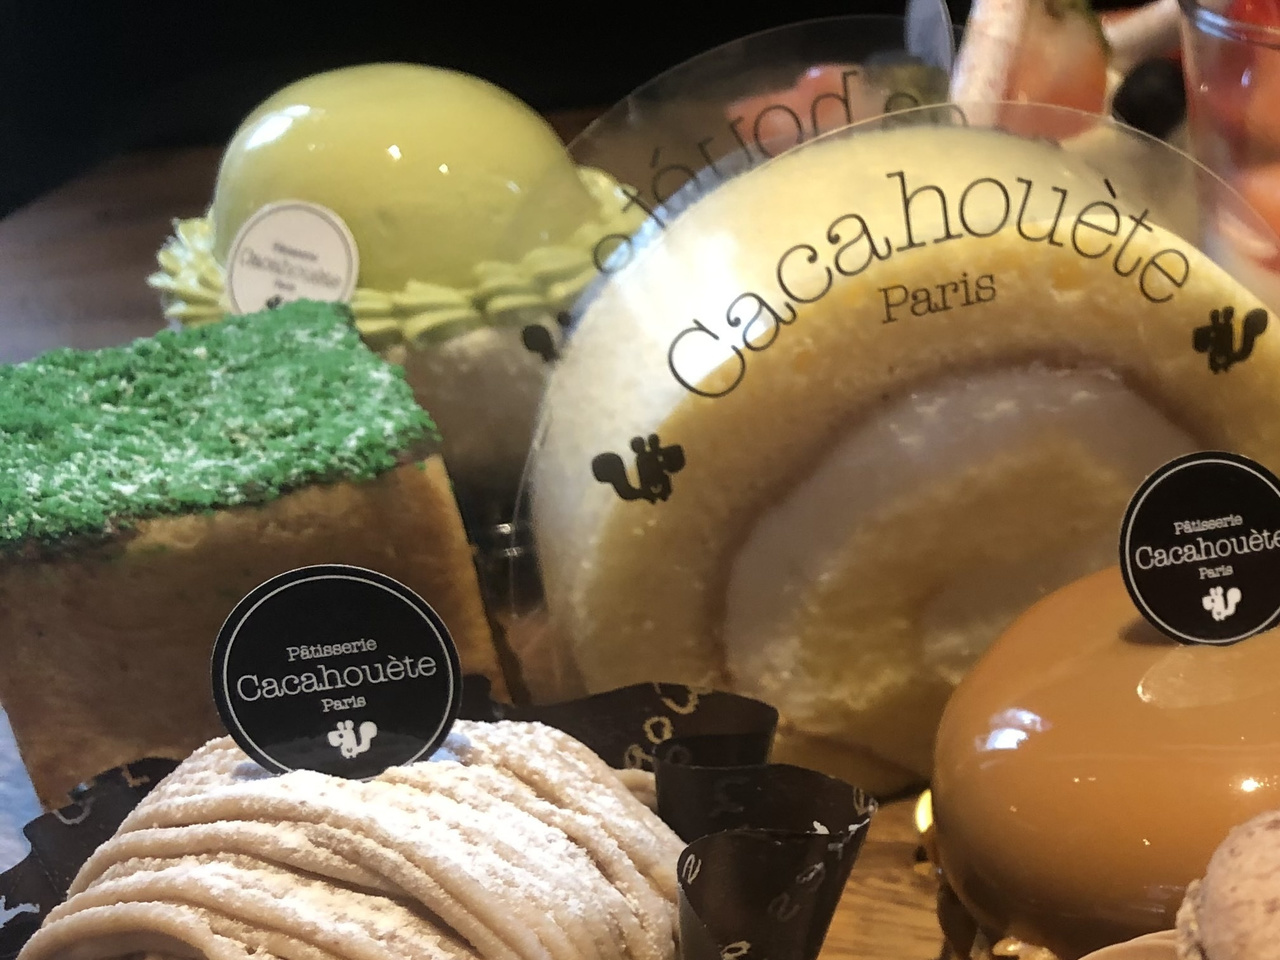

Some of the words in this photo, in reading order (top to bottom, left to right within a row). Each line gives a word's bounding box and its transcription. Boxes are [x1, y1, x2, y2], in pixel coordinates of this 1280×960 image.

[667, 169, 1191, 400] Cacahouète
[877, 270, 998, 325] Paris
[1173, 514, 1244, 536] Pâtisserie
[1199, 564, 1235, 580] Paris
[286, 638, 378, 662] Pâtisserie
[236, 655, 437, 702] Cacahouète
[321, 695, 367, 713] Paris
